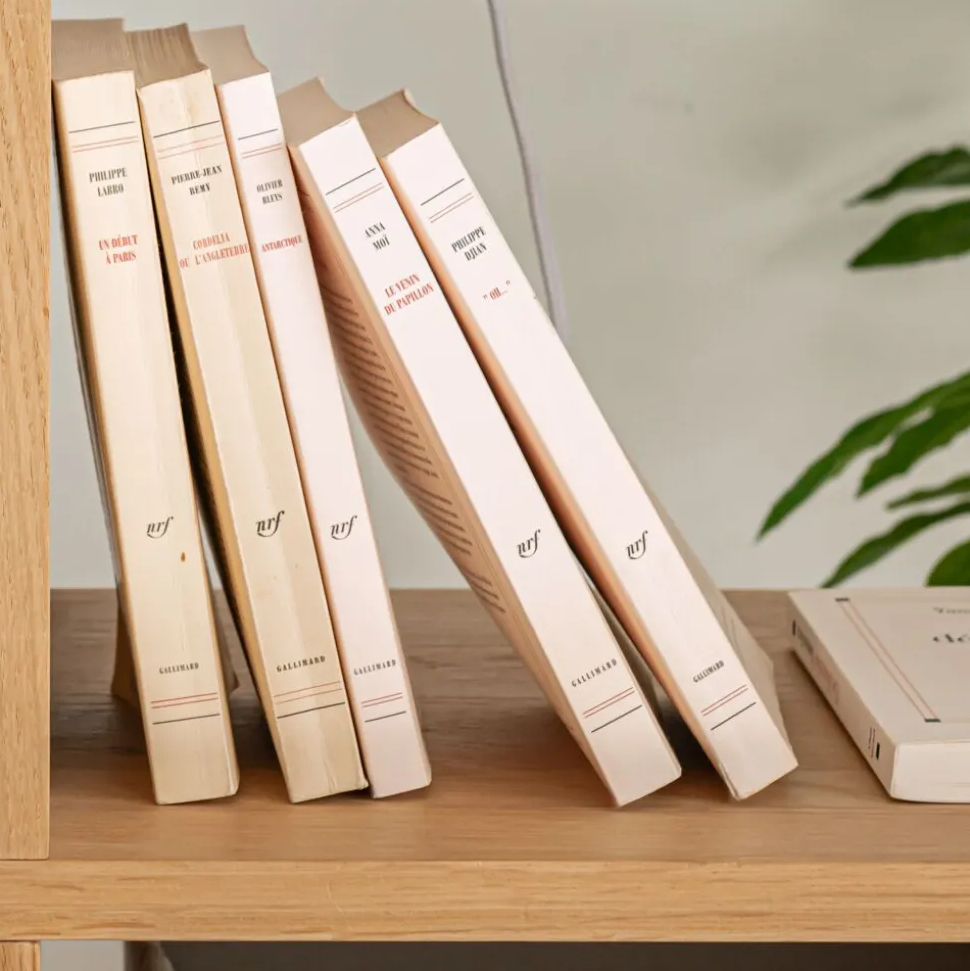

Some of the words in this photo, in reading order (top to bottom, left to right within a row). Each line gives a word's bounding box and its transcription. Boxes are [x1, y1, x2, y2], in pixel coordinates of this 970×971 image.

[89, 167, 127, 183] PHILIPPE
[171, 164, 222, 185] PIERRE-JEAN
[97, 183, 124, 197] LABRO
[189, 182, 211, 196] REMY
[256, 179, 283, 193] OLIVIER
[365, 221, 386, 238] ANNA
[99, 238, 109, 250] UN
[111, 234, 138, 248] DÉBUT
[192, 232, 231, 250] CORDELIA
[261, 234, 302, 253] ANTARCTIQUE
[451, 226, 487, 253] PHILIPPE
[113, 250, 137, 263] PARIS
[463, 242, 487, 261] DJIAN
[384, 285, 396, 299] LE
[395, 273, 421, 292] VENIN
[383, 302, 397, 316] DU
[396, 283, 435, 309] PAPILLON
[146, 516, 174, 539] nrf
[256, 510, 285, 537] nrf
[330, 515, 358, 540] nrf
[517, 529, 541, 558] nrf
[626, 530, 648, 559] nrf
[158, 662, 199, 675] GALLIMARD
[276, 655, 326, 673] GALLIMARD
[353, 659, 397, 676] GALLIMARD
[571, 658, 618, 688] GALLIMARD
[692, 660, 725, 683] GALLIMARD
